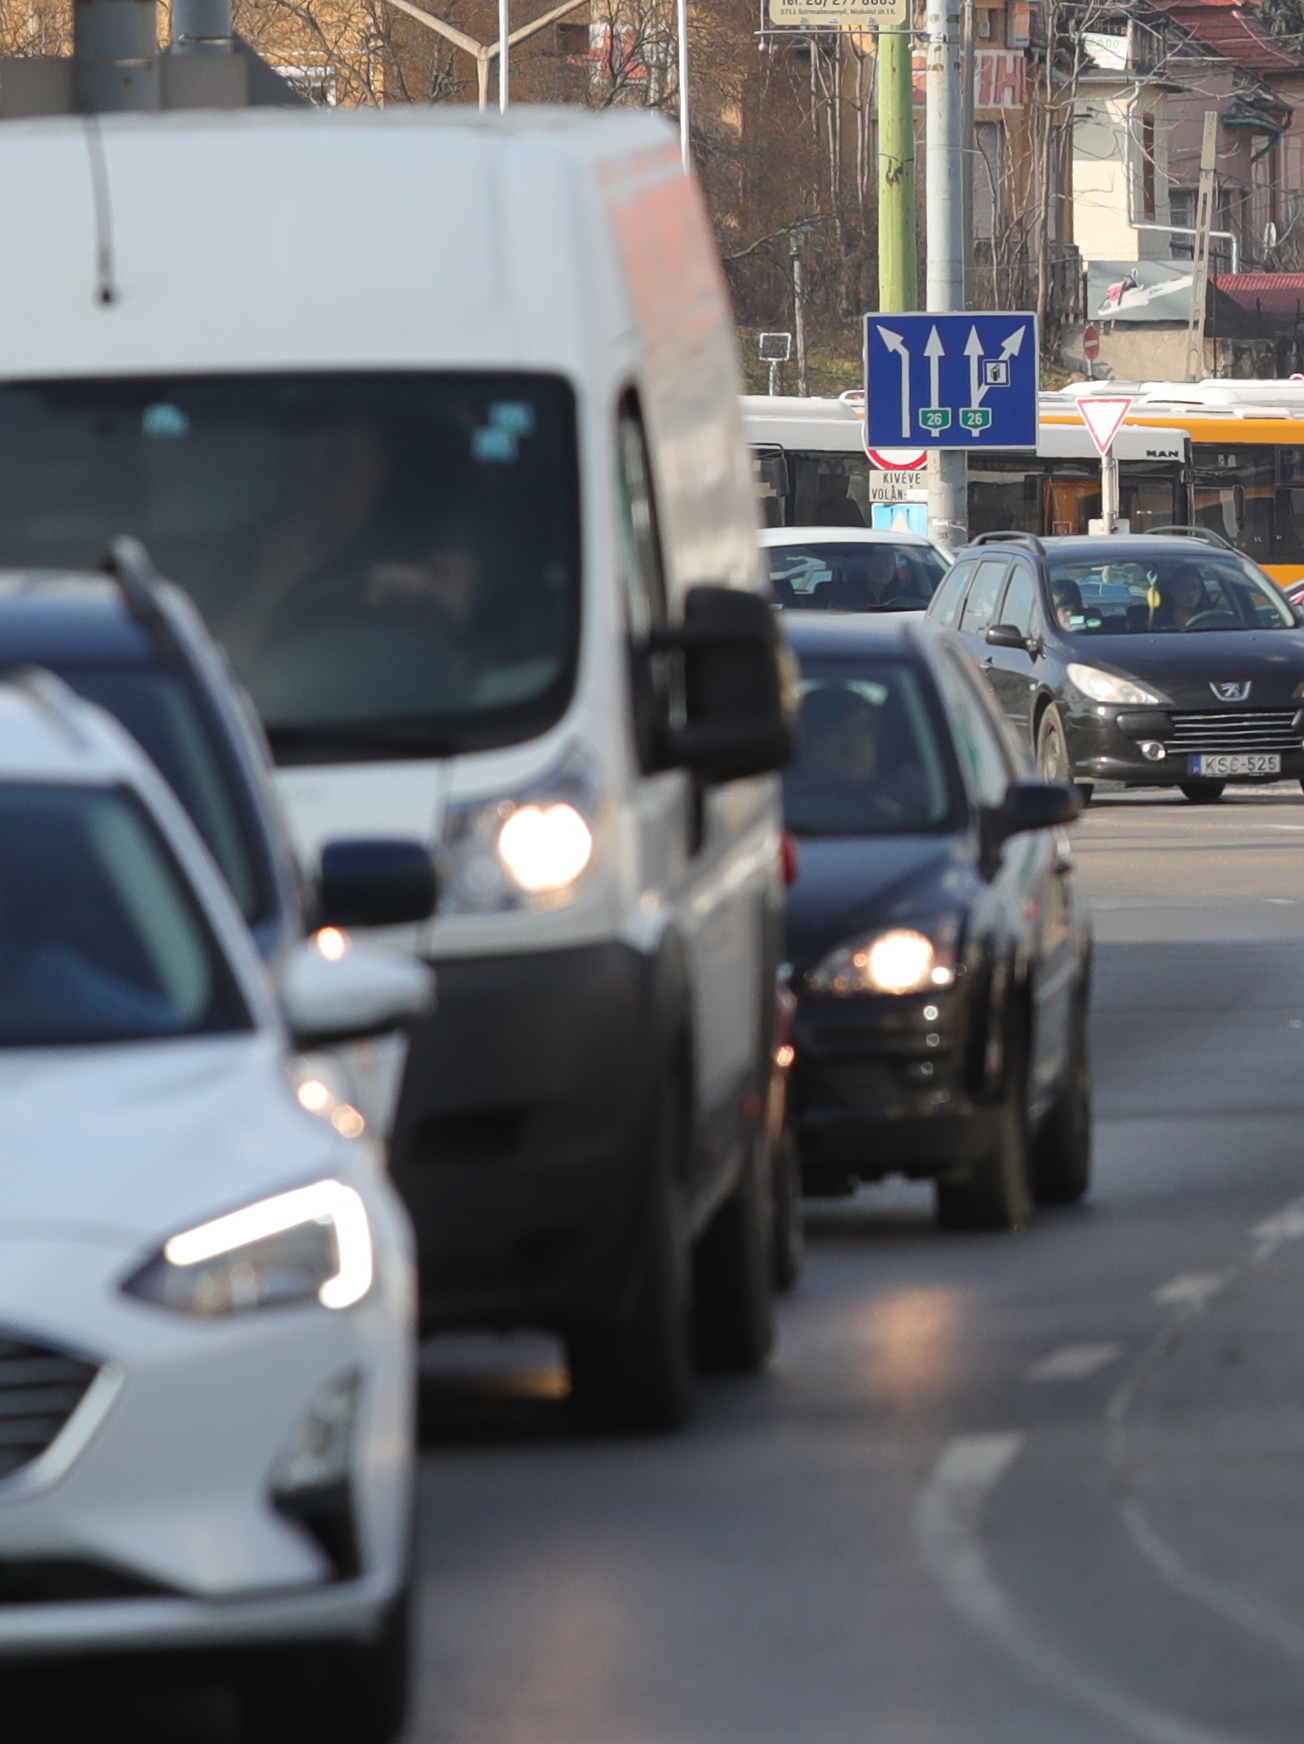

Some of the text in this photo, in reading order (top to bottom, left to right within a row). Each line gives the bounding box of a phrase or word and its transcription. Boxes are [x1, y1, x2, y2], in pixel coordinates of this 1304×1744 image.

[927, 413, 943, 426] 26
[967, 413, 983, 426] 26
[883, 471, 921, 484] KIVÉVE
[1204, 755, 1277, 773] KSC-525
